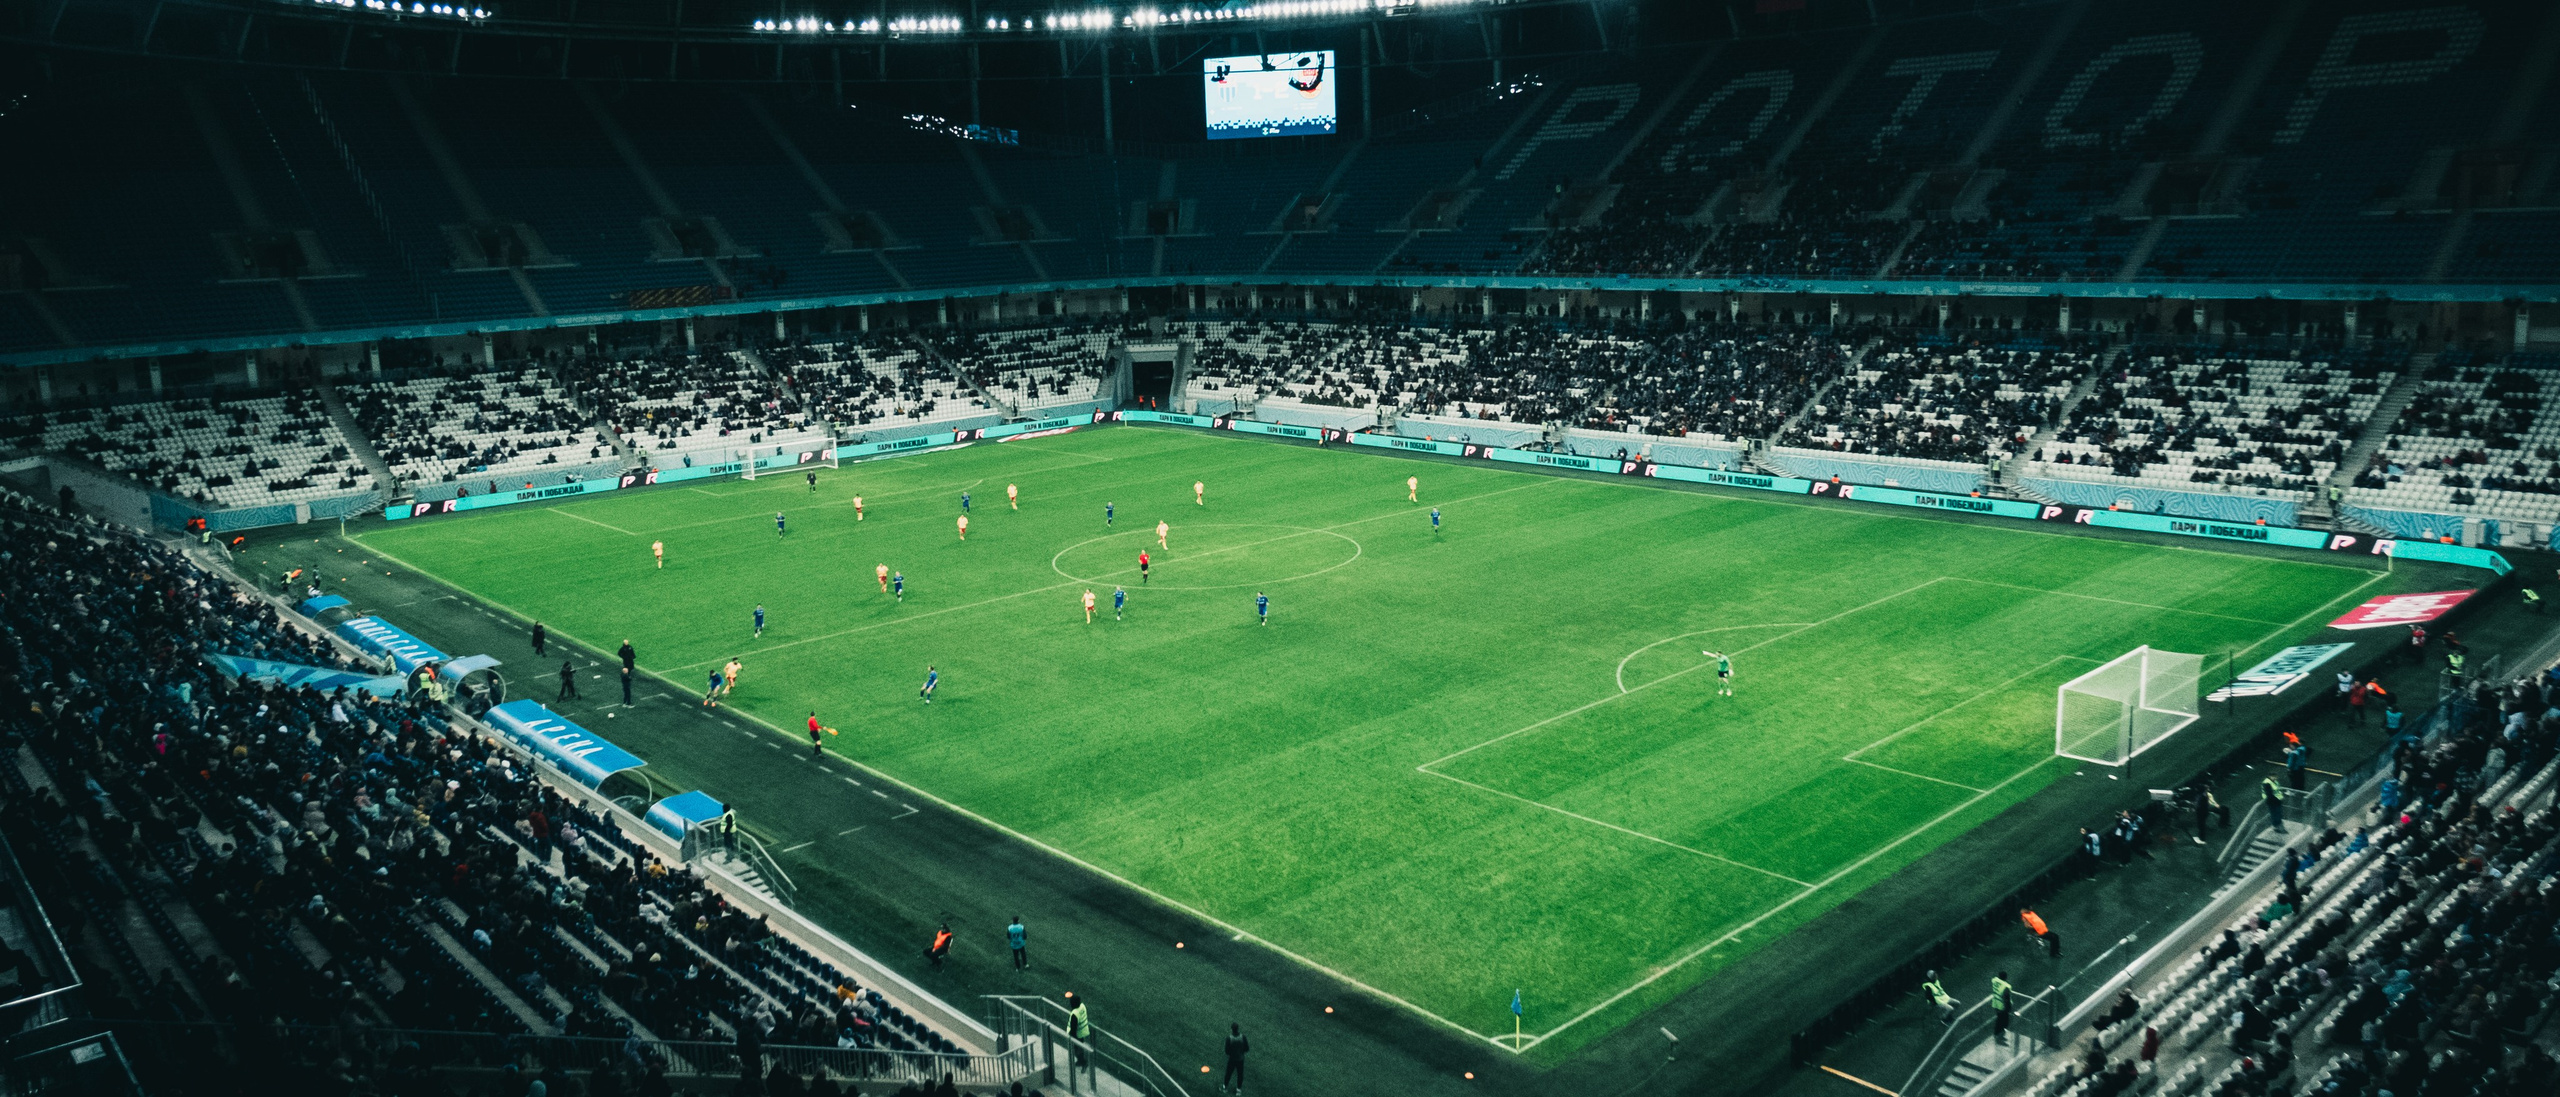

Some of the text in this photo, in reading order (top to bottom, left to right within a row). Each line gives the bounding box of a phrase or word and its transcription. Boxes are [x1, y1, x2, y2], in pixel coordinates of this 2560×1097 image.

[733, 459, 768, 471] ПОБЕДАЙ
[1708, 473, 1773, 488] ПАРИ И ПОБЕЖДАЙ
[516, 483, 584, 500] ПАРИ И ПОБЕЖДАЙ
[1915, 495, 1993, 512] ПАРИ И ПОБЕЖДАЙ
[2170, 521, 2268, 540] ПАРИ И ПОБЕЖДАЙ
[522, 718, 604, 758] АРЕНА
